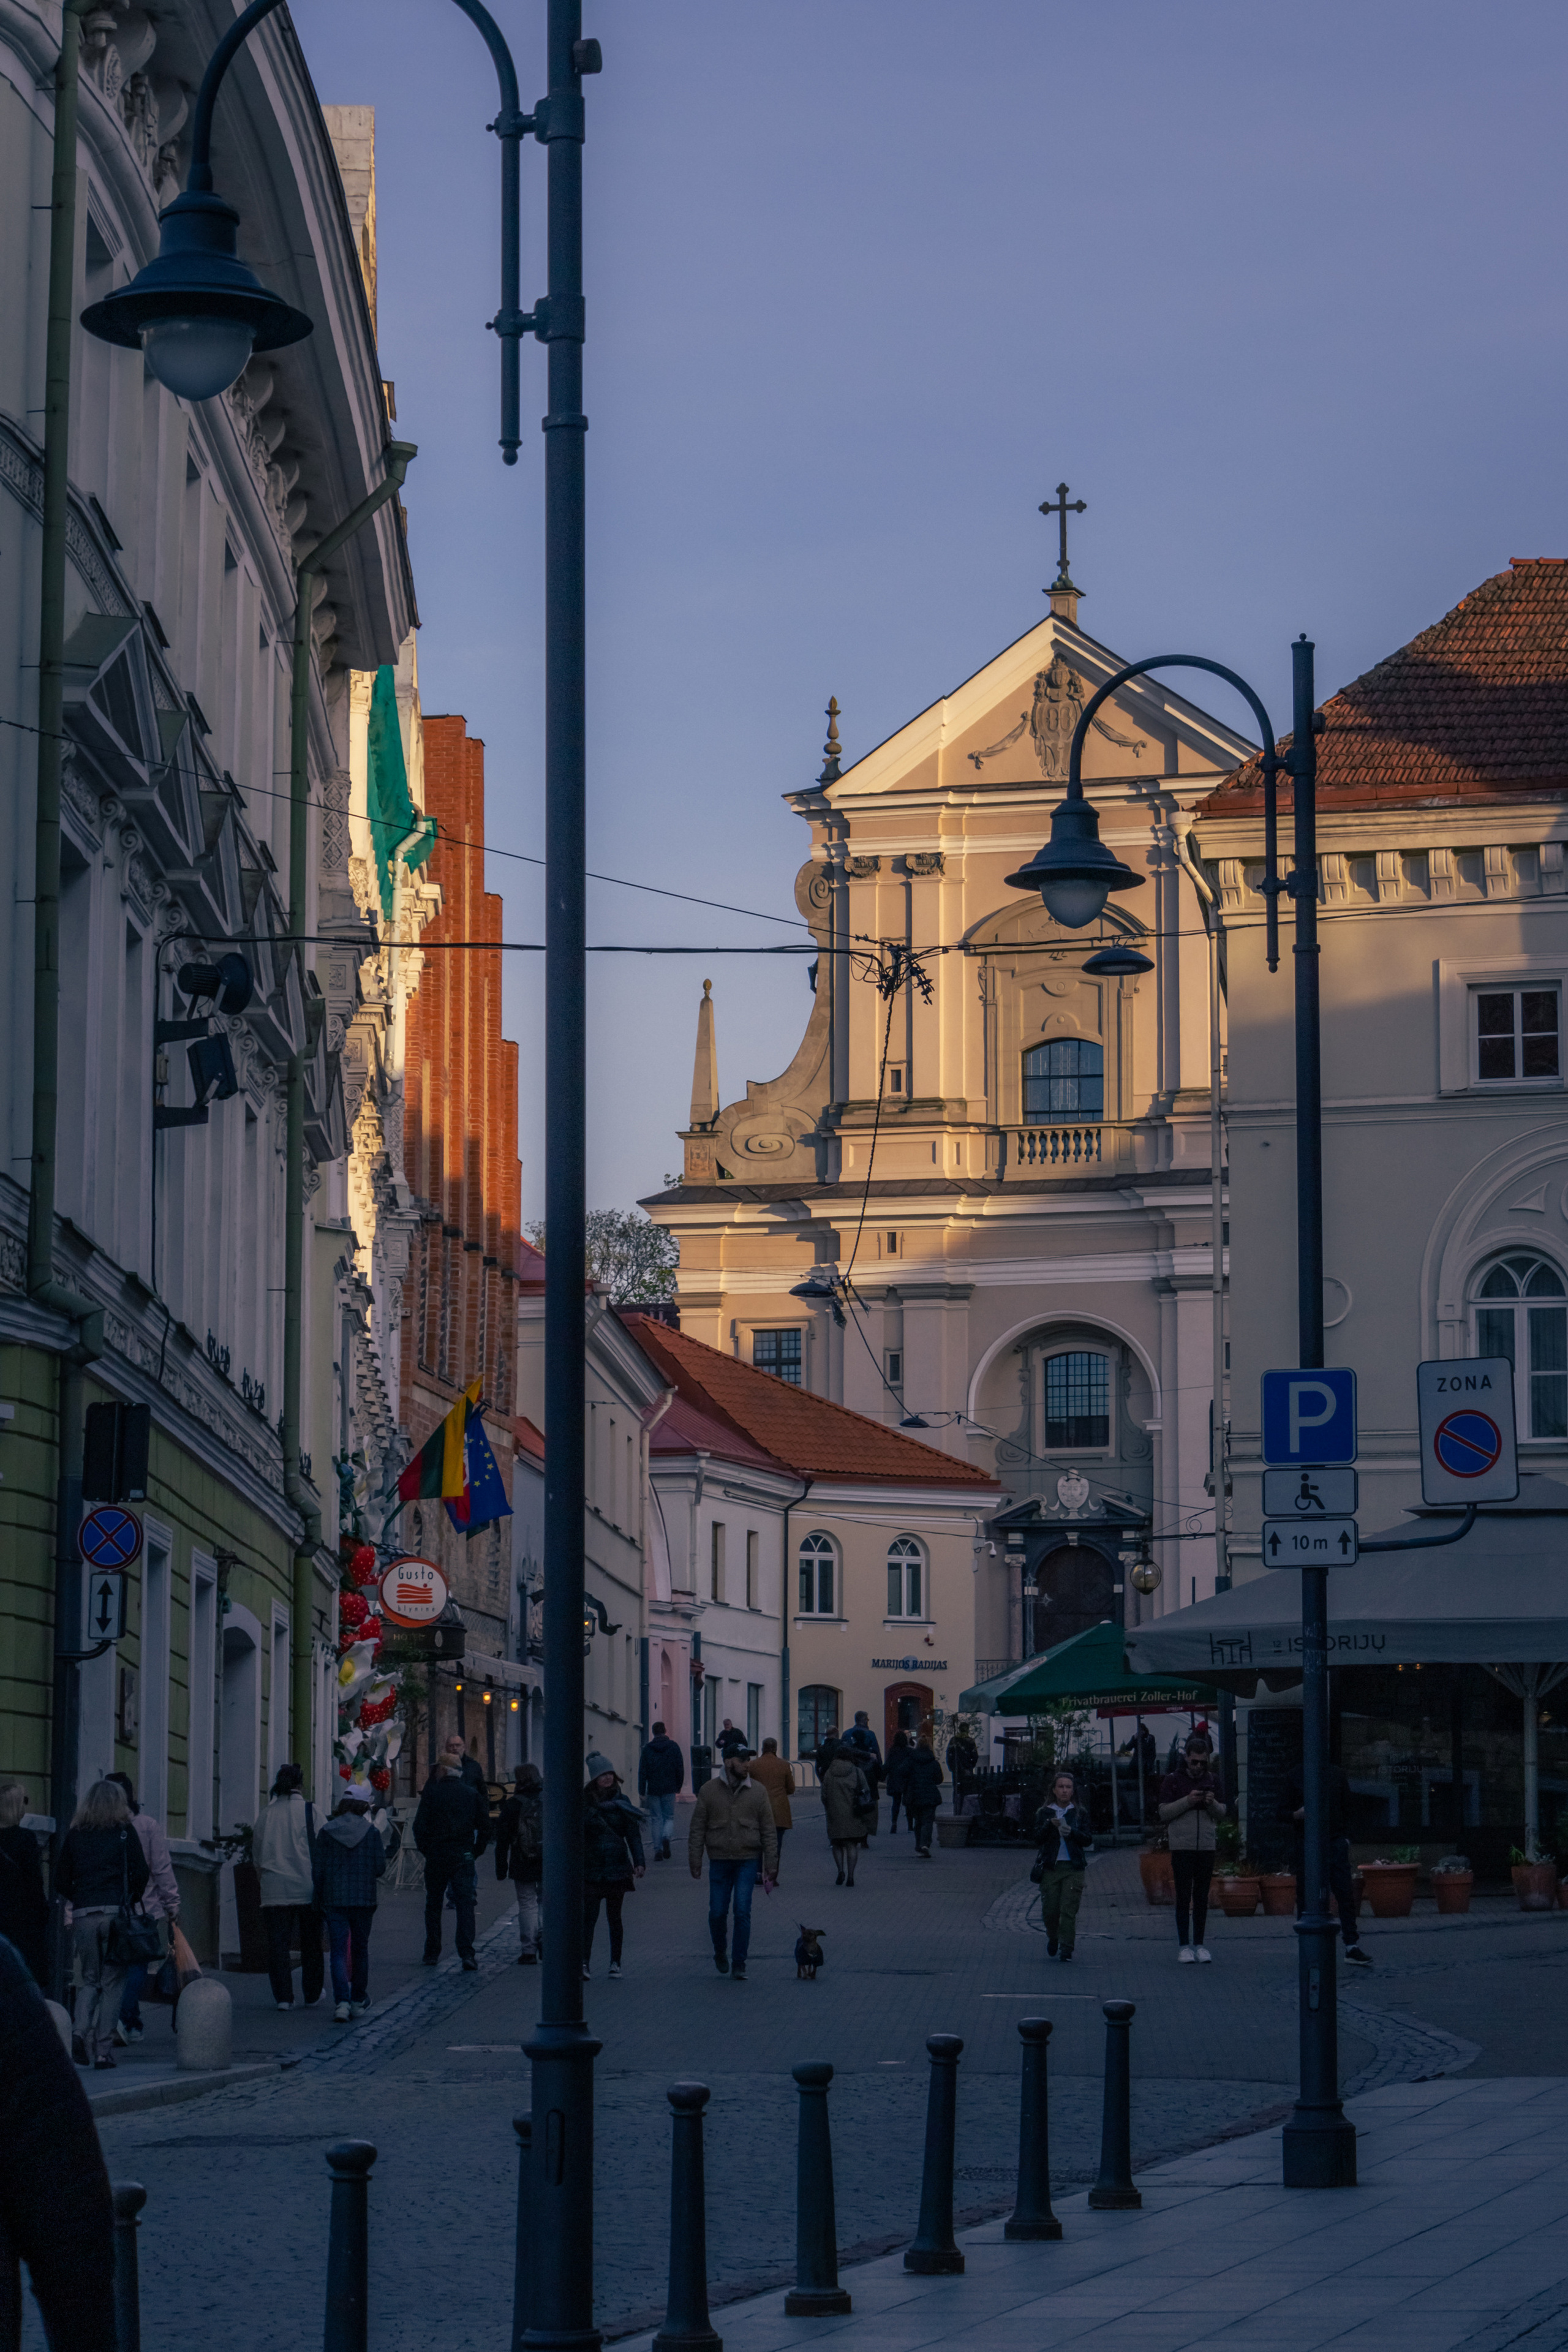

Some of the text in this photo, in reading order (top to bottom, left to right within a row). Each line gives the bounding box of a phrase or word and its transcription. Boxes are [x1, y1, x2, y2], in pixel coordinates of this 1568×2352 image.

[1437, 1375, 1492, 1392] ZONA
[1289, 1381, 1337, 1453] P
[1292, 1535, 1328, 1550] 10 m
[398, 1566, 434, 1580] Gusto
[1288, 1635, 1385, 1653] ISORIJŲ
[872, 1659, 948, 1671] MARIJOS RADIJAS
[1061, 1690, 1198, 1706] Privatbrauerei Zoller-Hof
